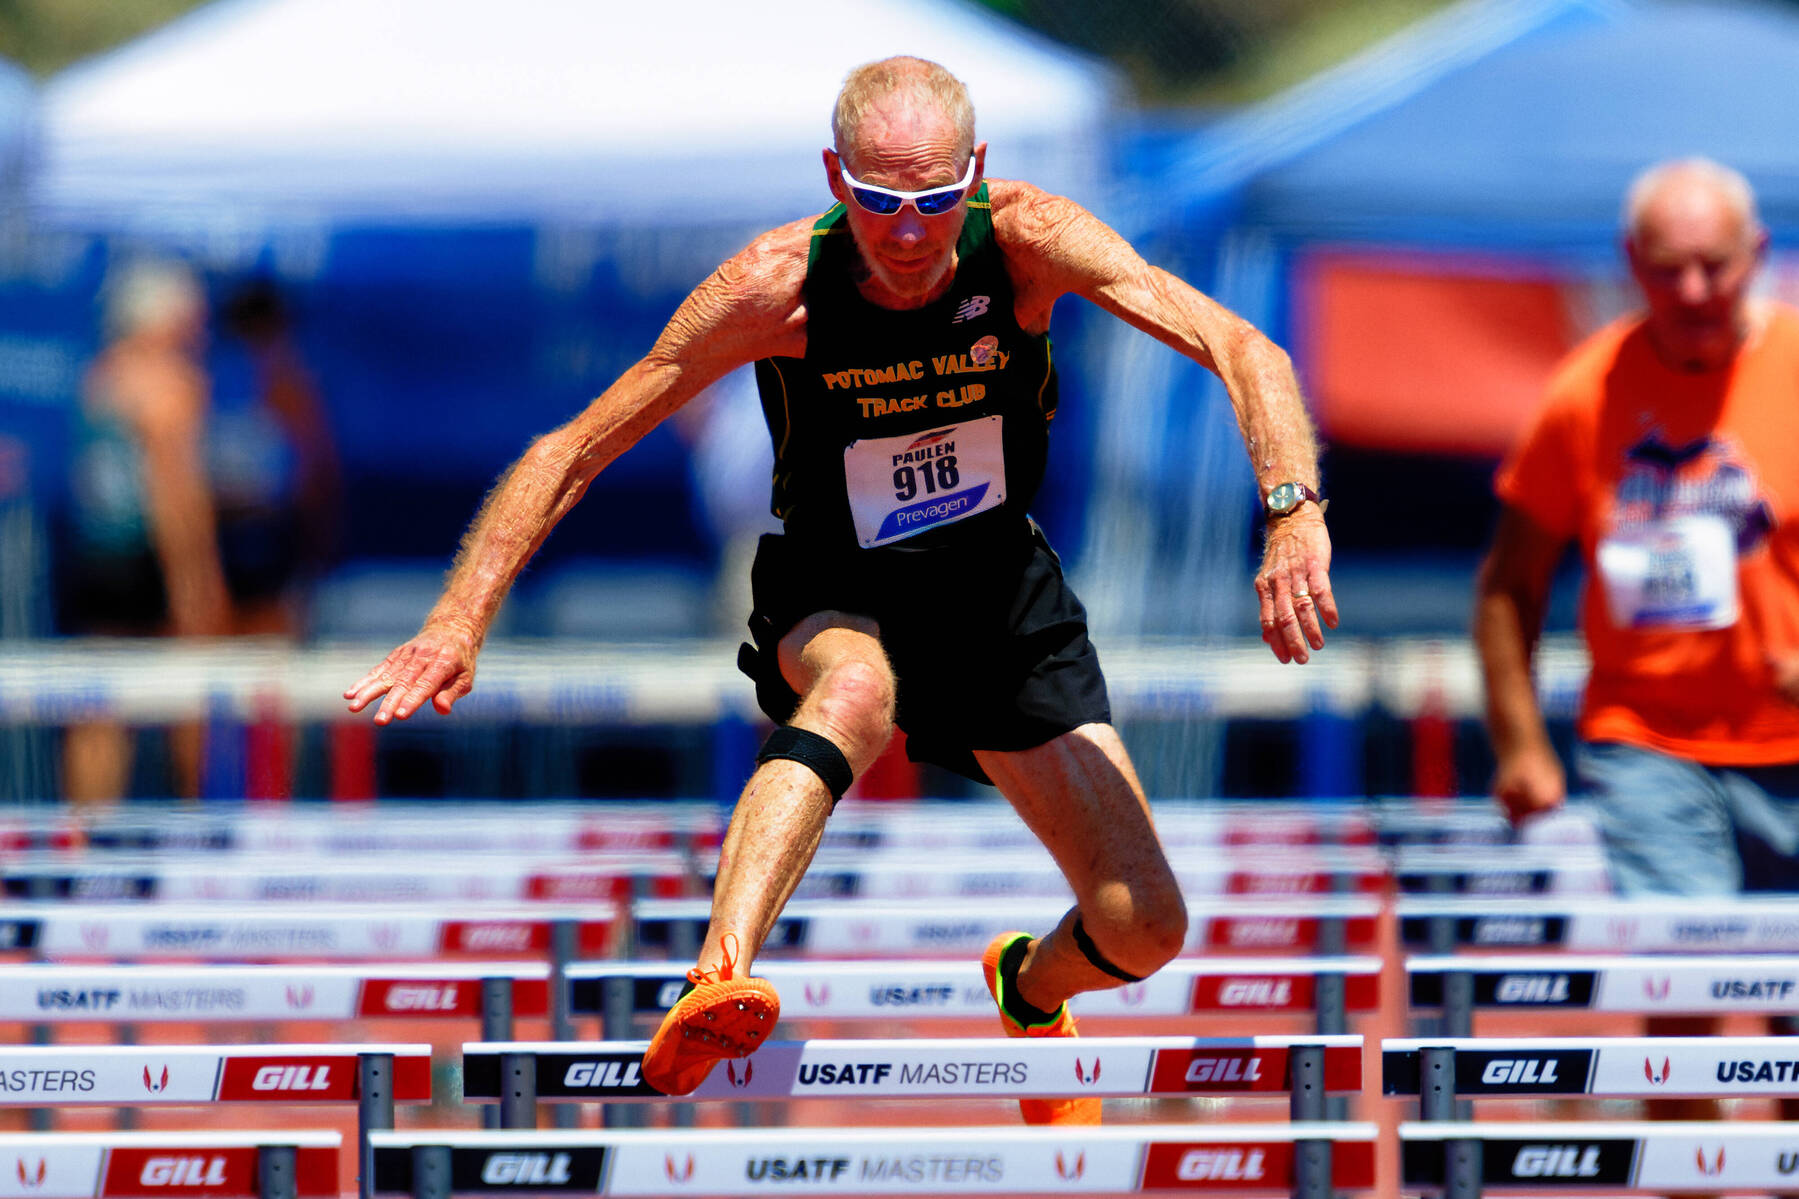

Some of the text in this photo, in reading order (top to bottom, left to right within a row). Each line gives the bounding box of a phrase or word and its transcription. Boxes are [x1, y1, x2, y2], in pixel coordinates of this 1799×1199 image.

[823, 351, 1010, 390] POTOMAC VALLEY
[857, 384, 986, 418] TRACK CLUB
[893, 441, 956, 467] PAULEN
[893, 455, 960, 501] 918
[896, 496, 968, 526] Prevagen
[37, 988, 121, 1010] USATF
[384, 985, 459, 1010] GILL
[1218, 981, 1291, 1006] GILL
[1496, 975, 1570, 1001] GILL
[1710, 978, 1795, 1001] USATF
[252, 1066, 330, 1091] GILL
[564, 1062, 641, 1087] GILL
[798, 1062, 1028, 1085] USATF MASTERS
[1185, 1058, 1262, 1082] GILL
[1482, 1060, 1559, 1084] GILL
[140, 1156, 227, 1186] GILL
[481, 1153, 572, 1185] GILL
[746, 1157, 1004, 1182] USATF MASTERS
[1176, 1149, 1265, 1181] GILL
[1512, 1146, 1601, 1178] GILL
